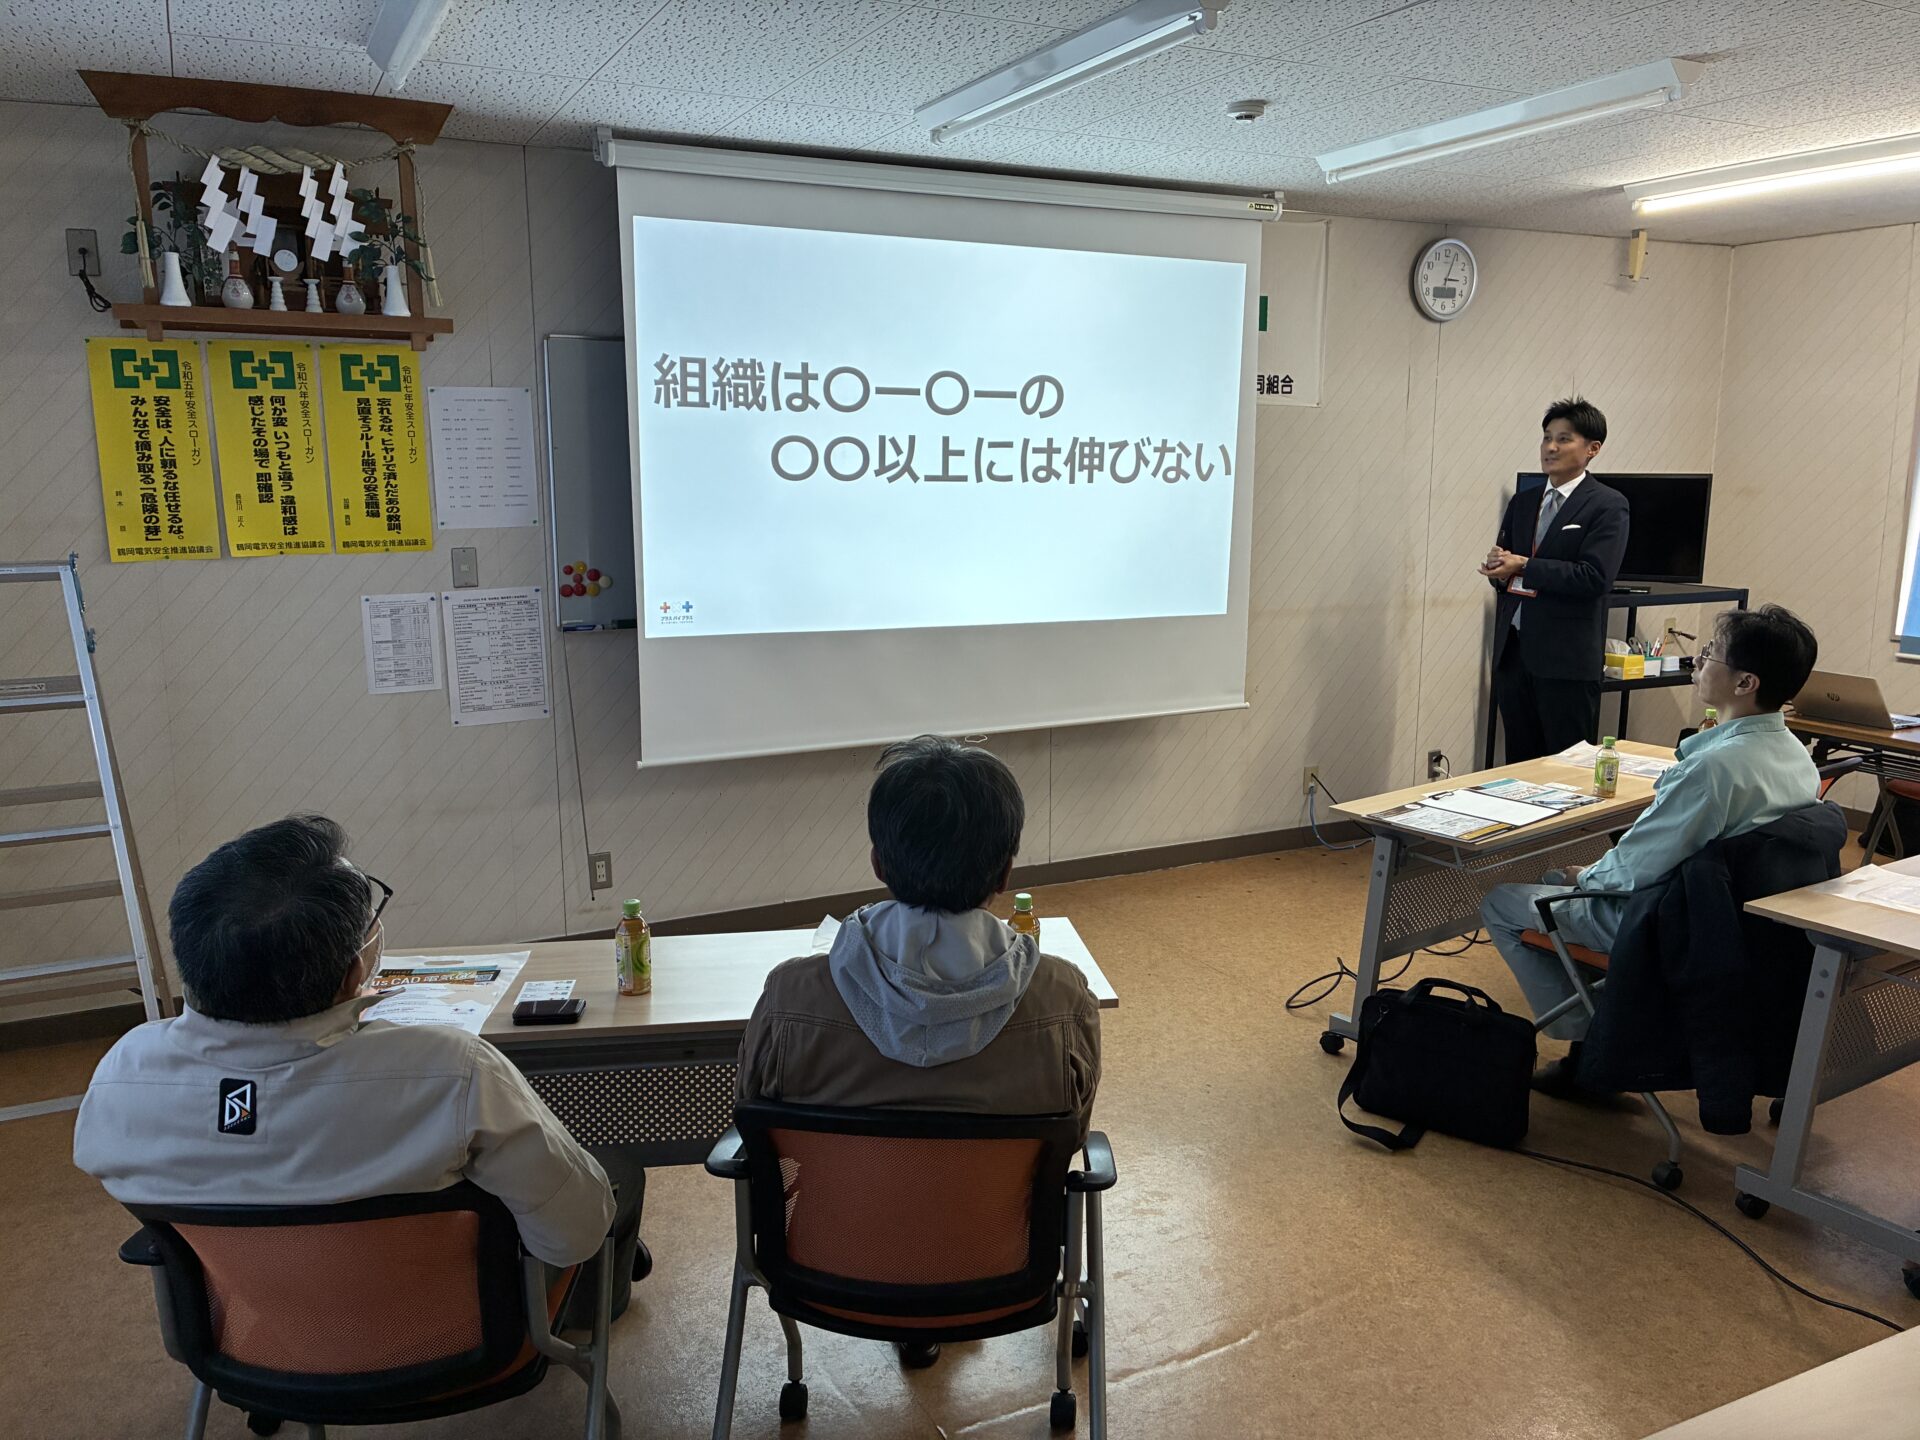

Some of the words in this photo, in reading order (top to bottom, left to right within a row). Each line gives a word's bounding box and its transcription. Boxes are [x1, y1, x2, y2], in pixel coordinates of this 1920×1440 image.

[1434, 252, 1440, 261] 11
[1444, 249, 1451, 257] 12
[1427, 261, 1434, 270] 10
[1461, 262, 1466, 271] 2
[1423, 274, 1428, 283] 9
[1462, 276, 1467, 285] 3
[1425, 287, 1430, 296] 8
[1458, 289, 1463, 298] 4
[1432, 299, 1437, 307] 7
[1440, 301, 1446, 310] 6
[1451, 300, 1456, 308] 5
[181, 361, 202, 466] 令和五年安全スローガン
[269, 395, 288, 427] 何か変
[296, 362, 315, 464] 令和六年安全スローガン
[401, 365, 418, 464] 令和七年安全スローガン
[248, 395, 270, 469] 感じたその場で
[273, 431, 294, 492] いつもと違う
[356, 398, 381, 518] 見直そうルール厳守の安全職場
[130, 395, 162, 541] みんなで摘み取る「危険の芽」
[153, 395, 184, 540] 安全は、人に頼るな任せるな。
[376, 398, 402, 536] 忘れるな、ヒヤリで済んだあの教訓、
[255, 472, 275, 504] 即確認
[280, 495, 298, 536] 違和感は
[236, 541, 325, 551] 鶴岡電気安全推進協議会
[342, 538, 427, 548] 鶴岡電気安全推進協議会
[117, 546, 214, 556] 鶴岡電気安全推進協議会
